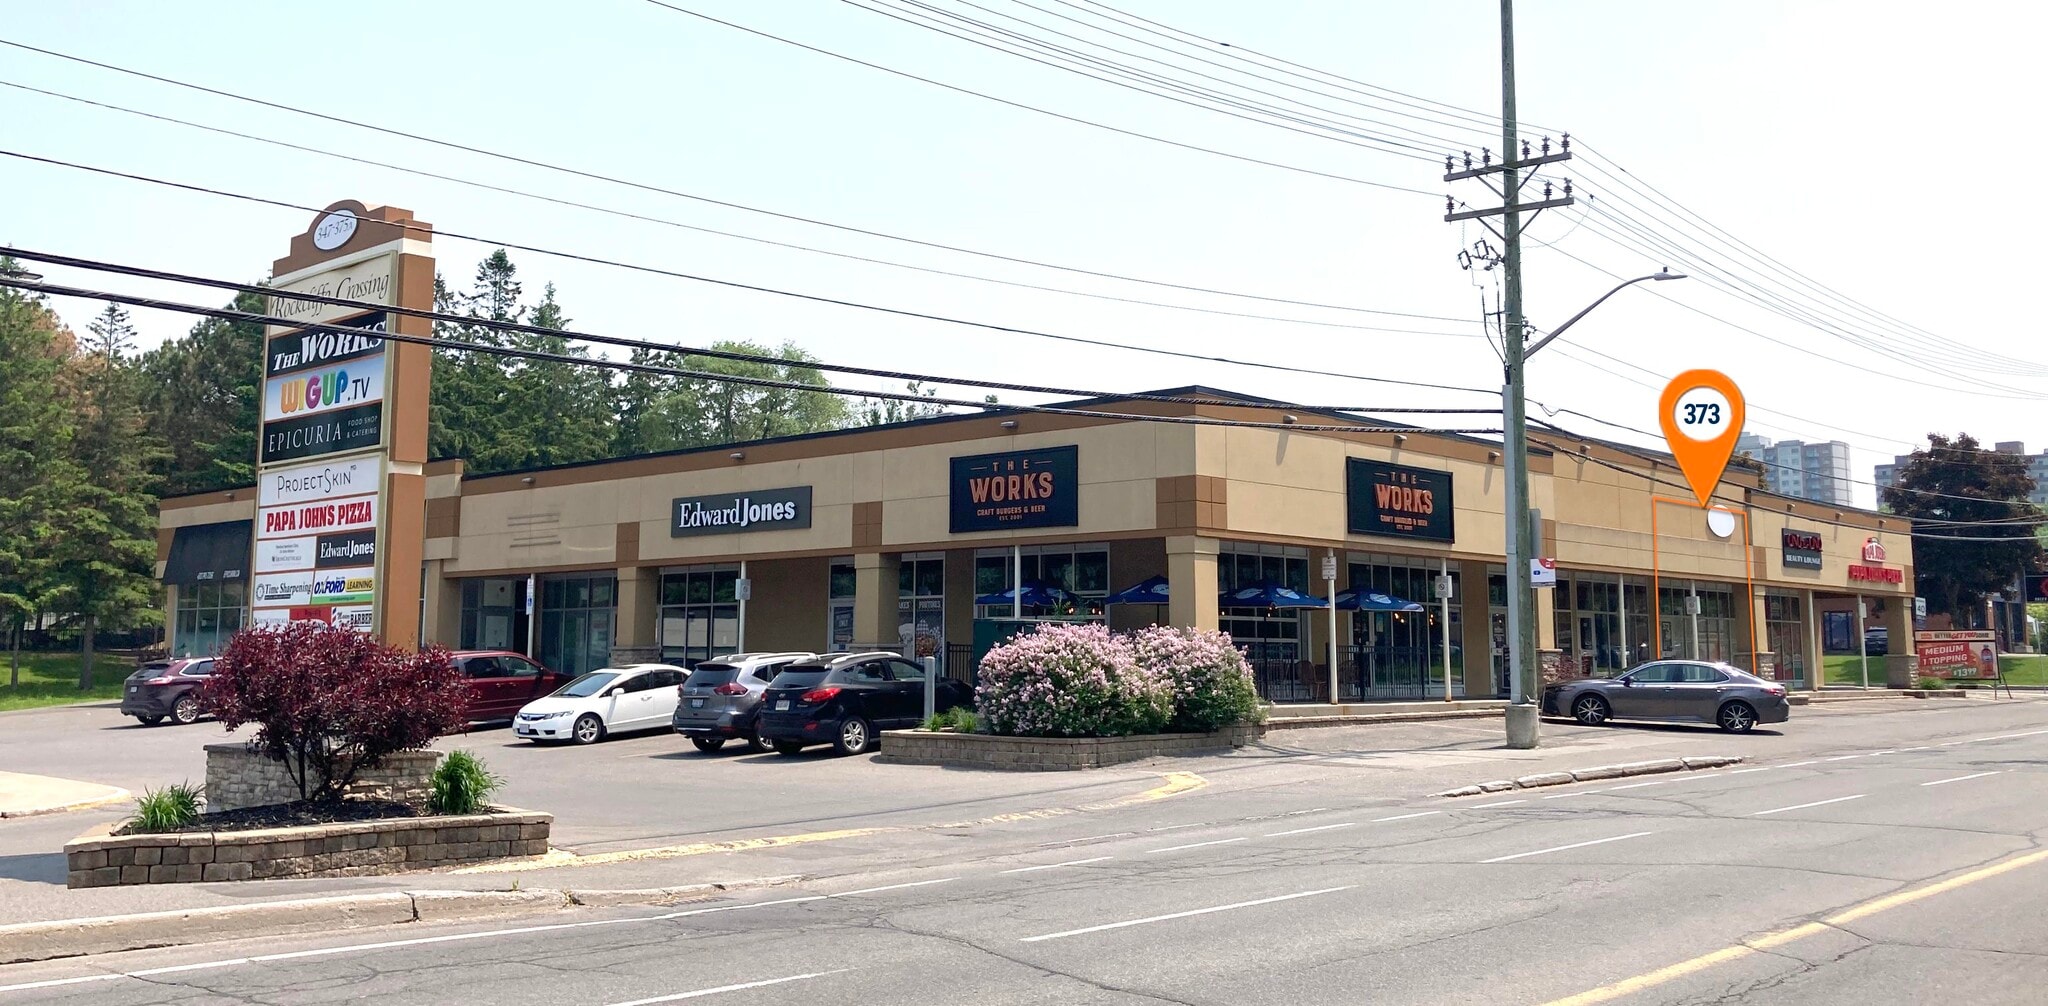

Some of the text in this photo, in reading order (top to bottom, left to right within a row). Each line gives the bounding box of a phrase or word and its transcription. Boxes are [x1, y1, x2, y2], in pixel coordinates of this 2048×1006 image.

[335, 273, 390, 300] Crossing
[301, 320, 386, 364] WORKS
[268, 415, 378, 453] EPICURIA FOOD SHOP
[351, 427, 377, 438] CATERING
[992, 459, 1030, 472] THE
[1390, 472, 1417, 484] THE
[969, 472, 1054, 504] WORKS
[1375, 483, 1433, 515] WORKS
[265, 501, 372, 532] PAPA JOHN'S PIZZA
[976, 508, 994, 517] CRAFT
[996, 506, 1022, 516] BURGERS
[1030, 505, 1046, 513] BEER
[1786, 554, 1821, 565] BEAUTY LOUNGE
[265, 582, 312, 596] Time Sharpening
[314, 576, 373, 595] OXFORD LEARNING
[1916, 604, 1926, 614] 40
[1951, 632, 1964, 640] GET
[1924, 644, 1964, 656] MEDIUM
[1929, 653, 1968, 665] TOPPING
